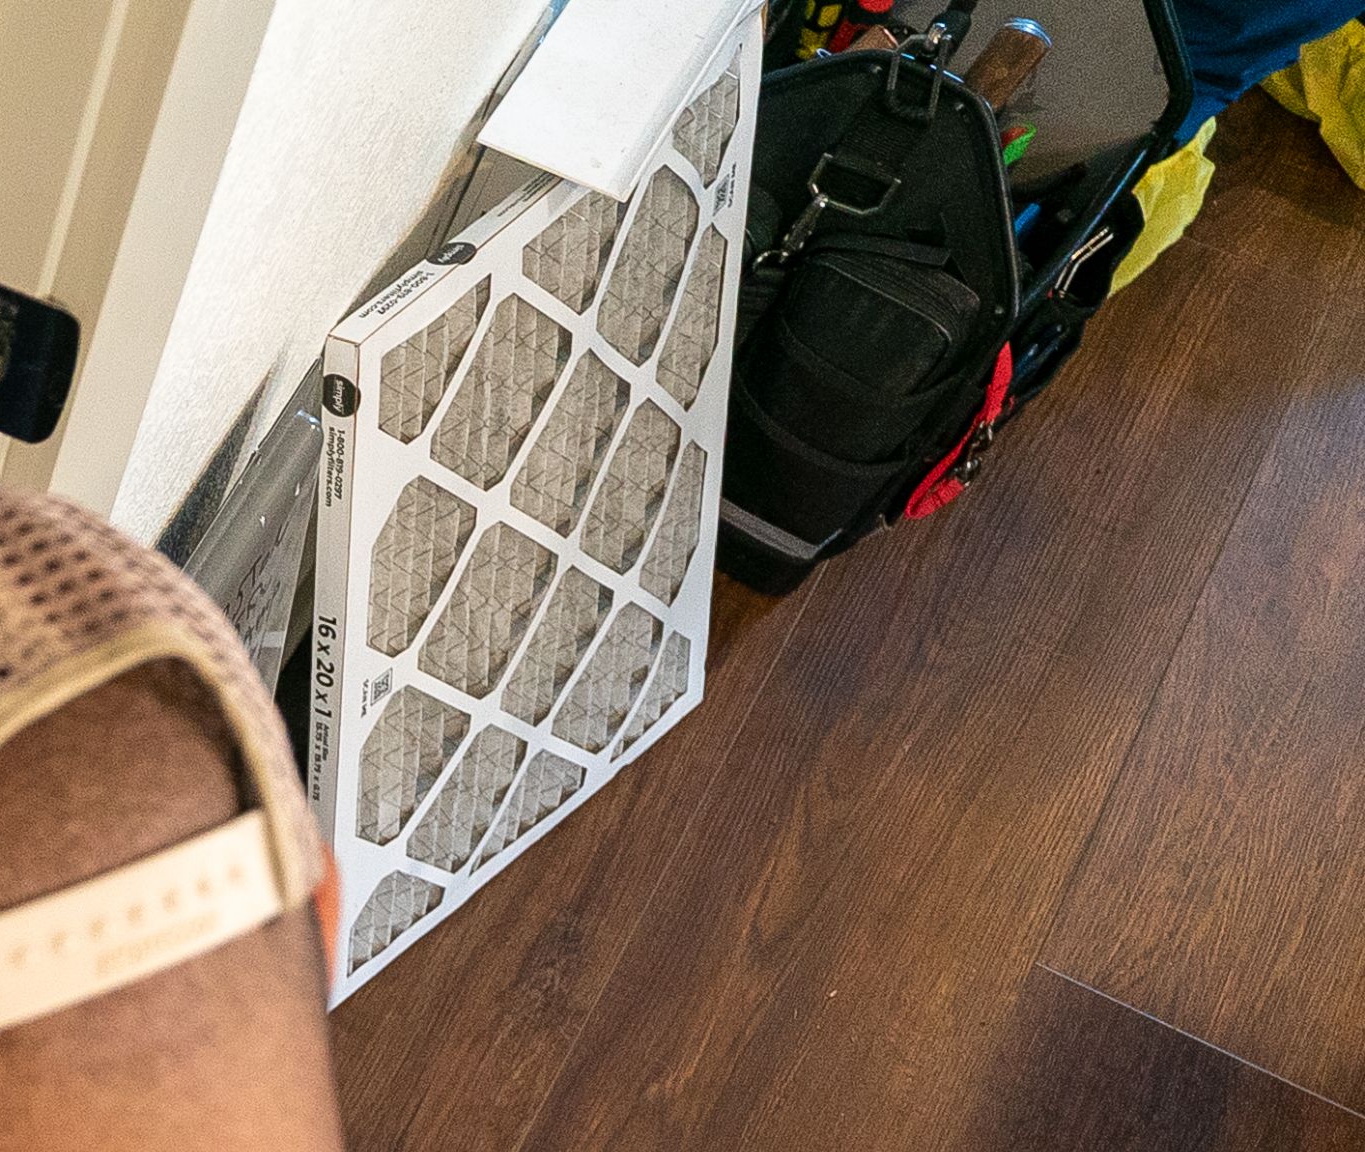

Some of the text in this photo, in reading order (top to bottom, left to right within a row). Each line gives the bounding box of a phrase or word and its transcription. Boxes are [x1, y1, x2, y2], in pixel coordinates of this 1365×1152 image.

[332, 380, 346, 412] simply
[325, 427, 337, 507] simplyfilters.com
[315, 616, 337, 718] 16 x 20 x 1
